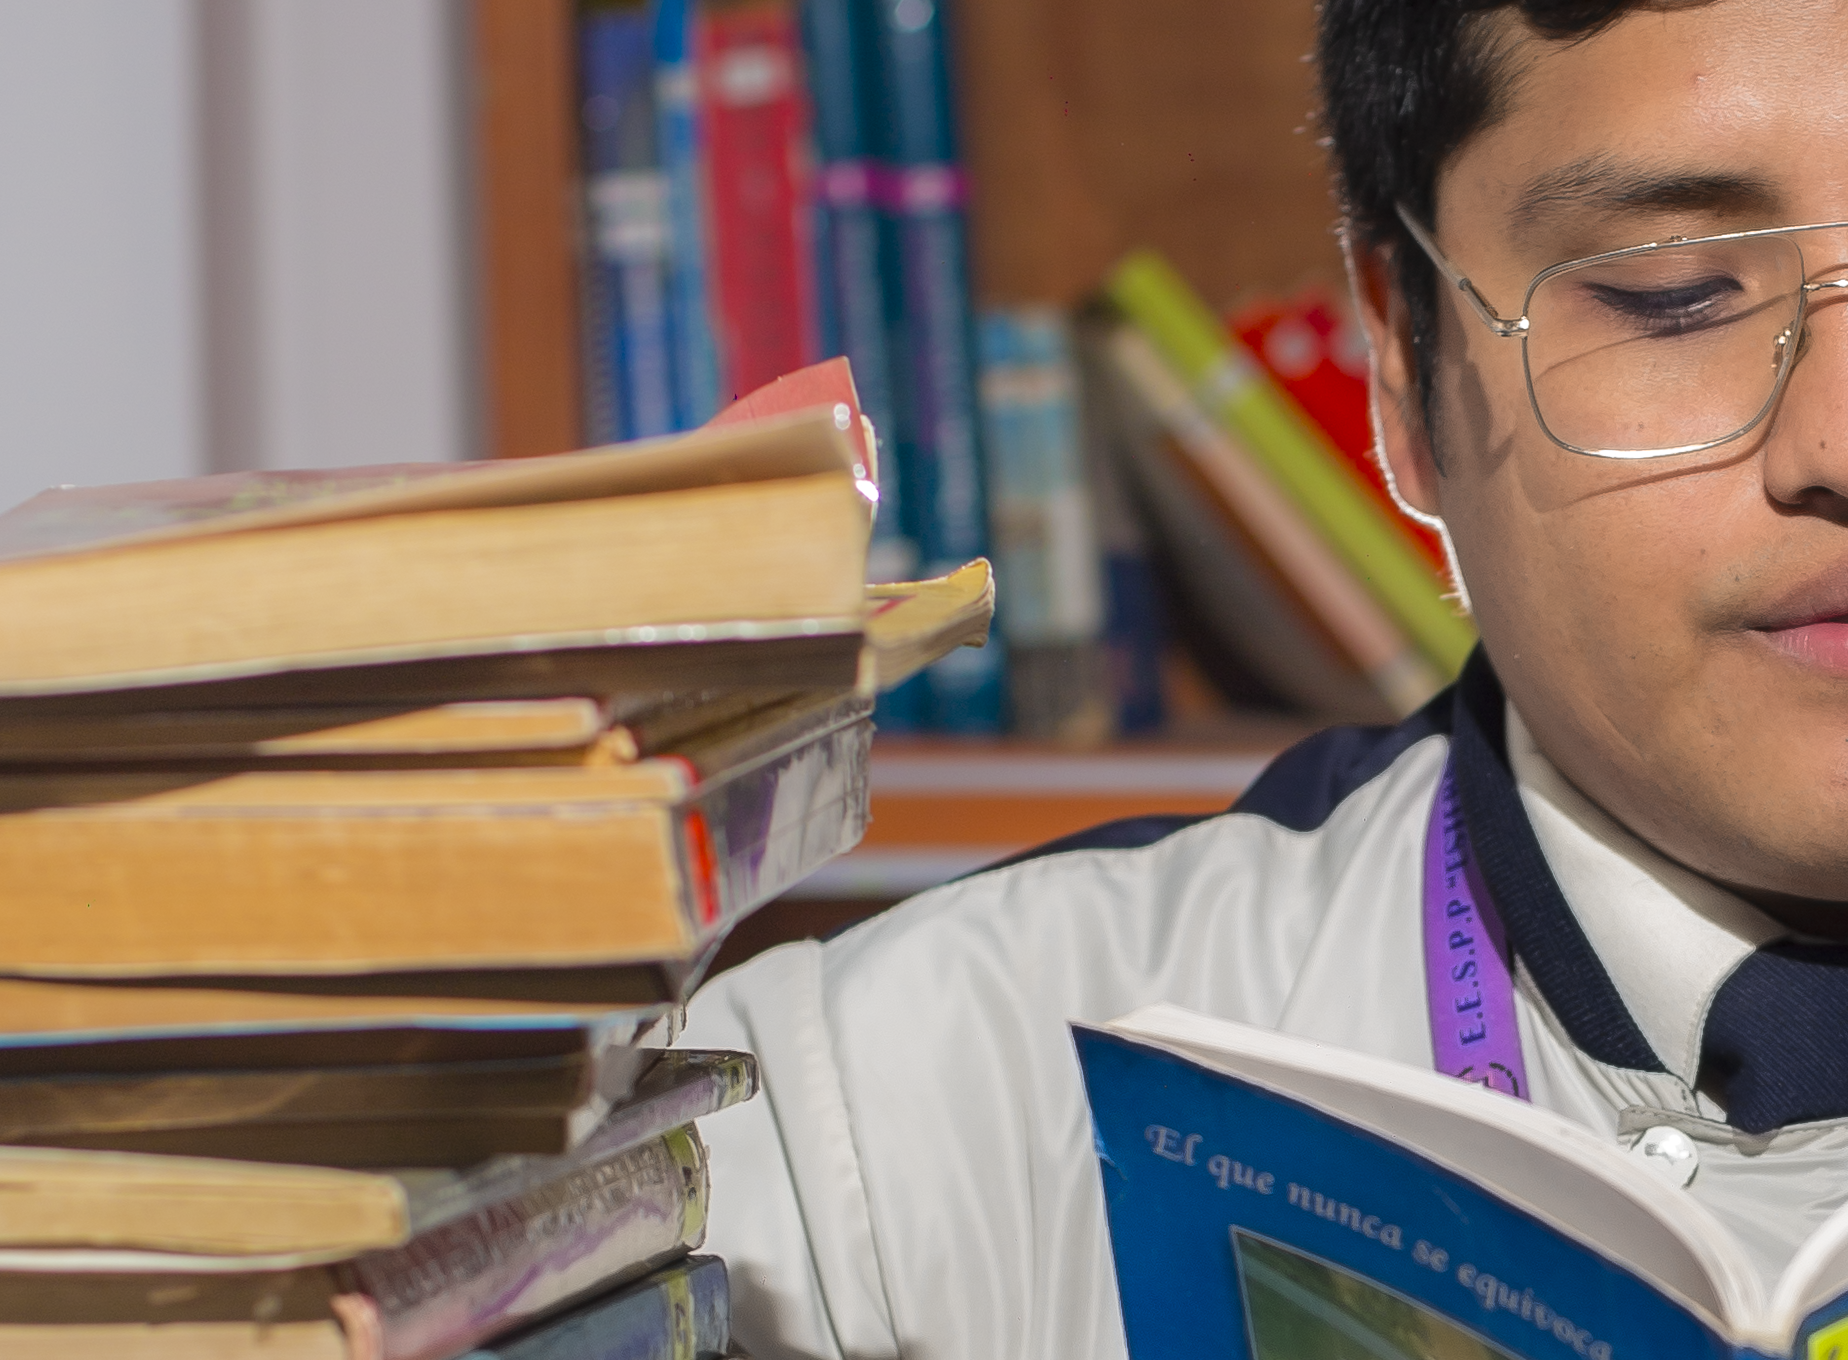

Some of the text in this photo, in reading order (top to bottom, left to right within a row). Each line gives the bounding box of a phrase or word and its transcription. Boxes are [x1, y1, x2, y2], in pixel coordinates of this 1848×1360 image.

[1143, 1123, 1204, 1167] El
[1206, 1153, 1276, 1196] que
[1286, 1181, 1405, 1252] nunca
[1410, 1238, 1450, 1274] se
